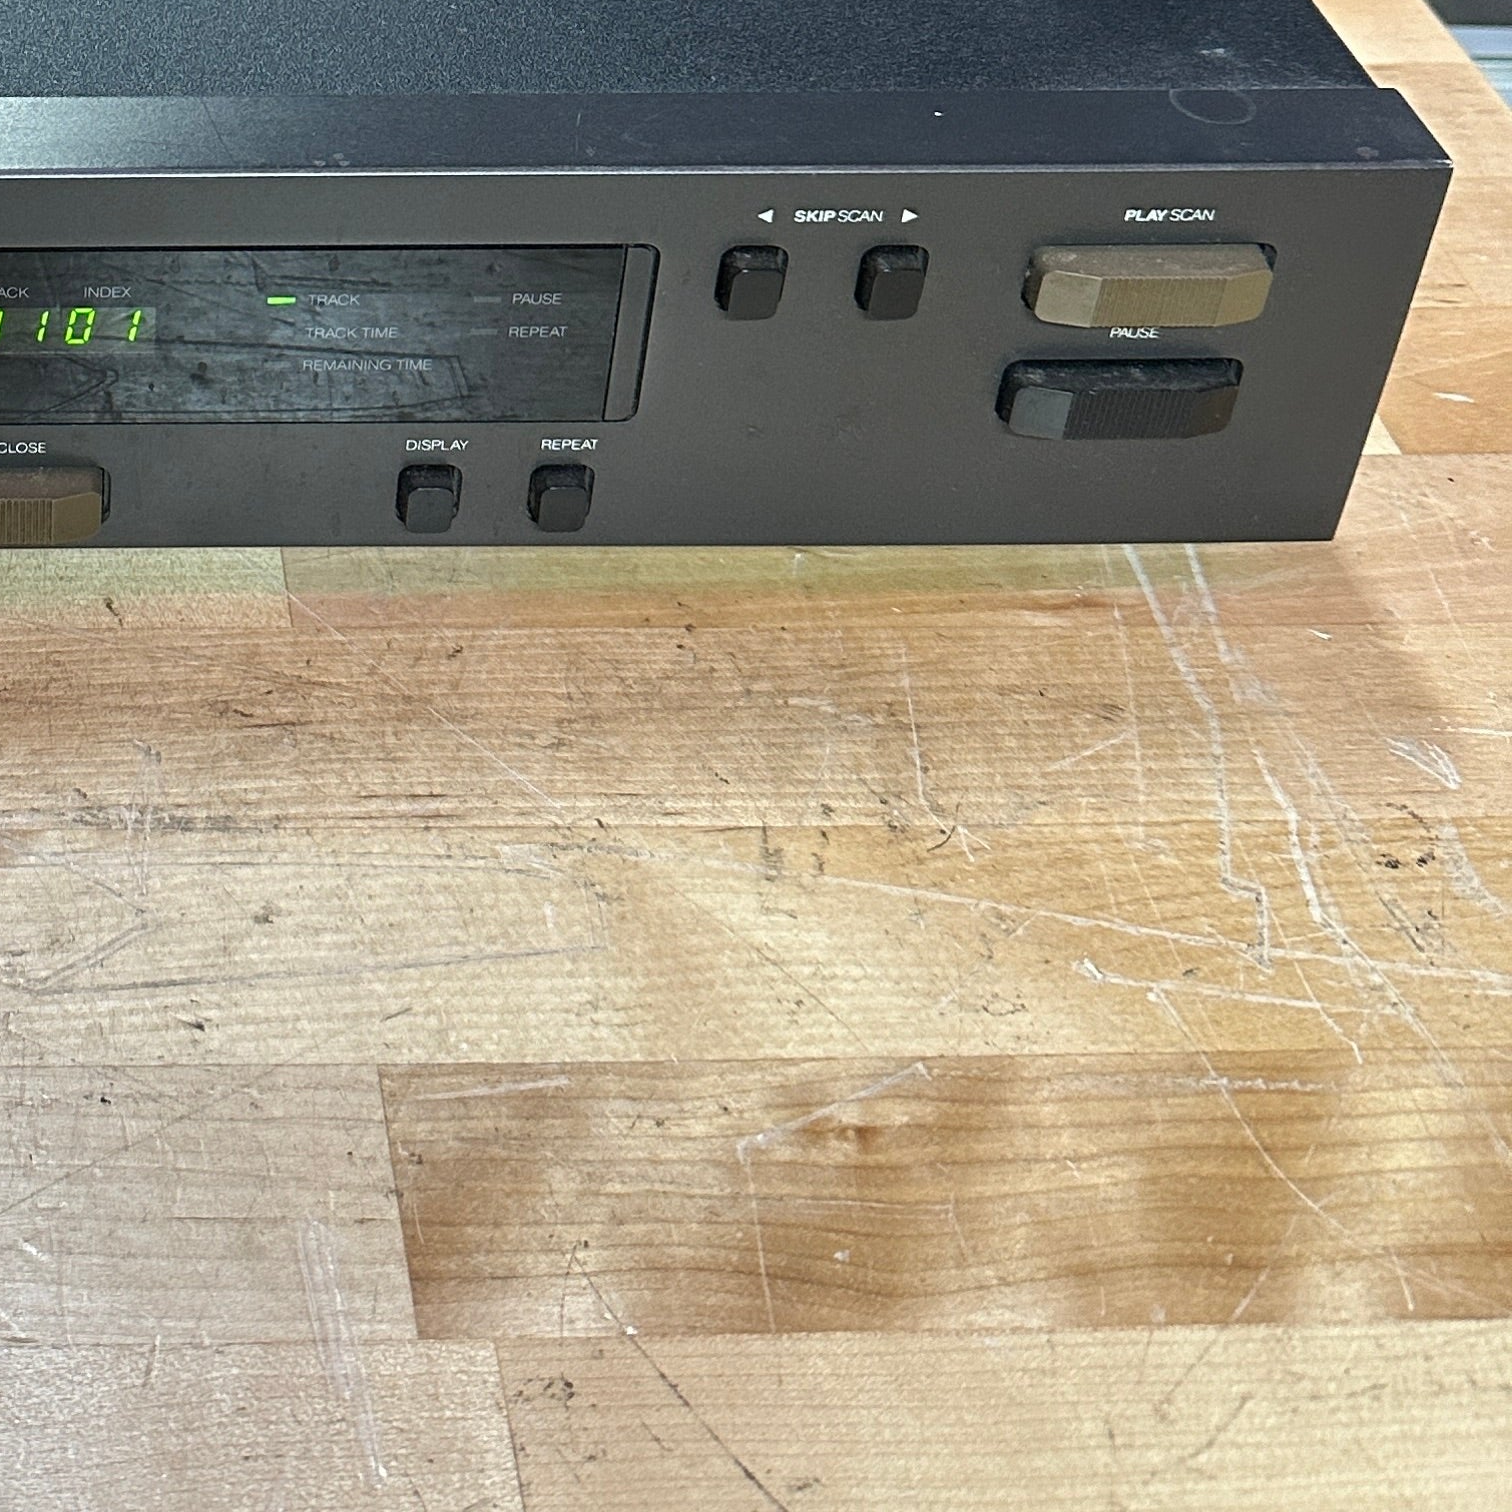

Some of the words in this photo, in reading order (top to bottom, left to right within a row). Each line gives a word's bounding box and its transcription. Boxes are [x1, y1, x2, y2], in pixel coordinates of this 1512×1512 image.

[793, 209, 837, 223] SKIP
[838, 209, 884, 223] SCAN
[1123, 209, 1168, 222] PLAY
[1169, 209, 1216, 222] SCAN
[83, 286, 133, 299] INDEX
[308, 293, 361, 305] TRACK
[511, 293, 564, 305] PAUSE
[304, 327, 358, 339] TRACK
[362, 327, 400, 339] TIME
[507, 326, 569, 338] REPEAT
[1109, 327, 1161, 339] PAUSE
[302, 359, 392, 372] REMAINING
[396, 359, 433, 372] TIME
[404, 439, 469, 451] DISPLAY
[540, 438, 599, 451] REPEAT
